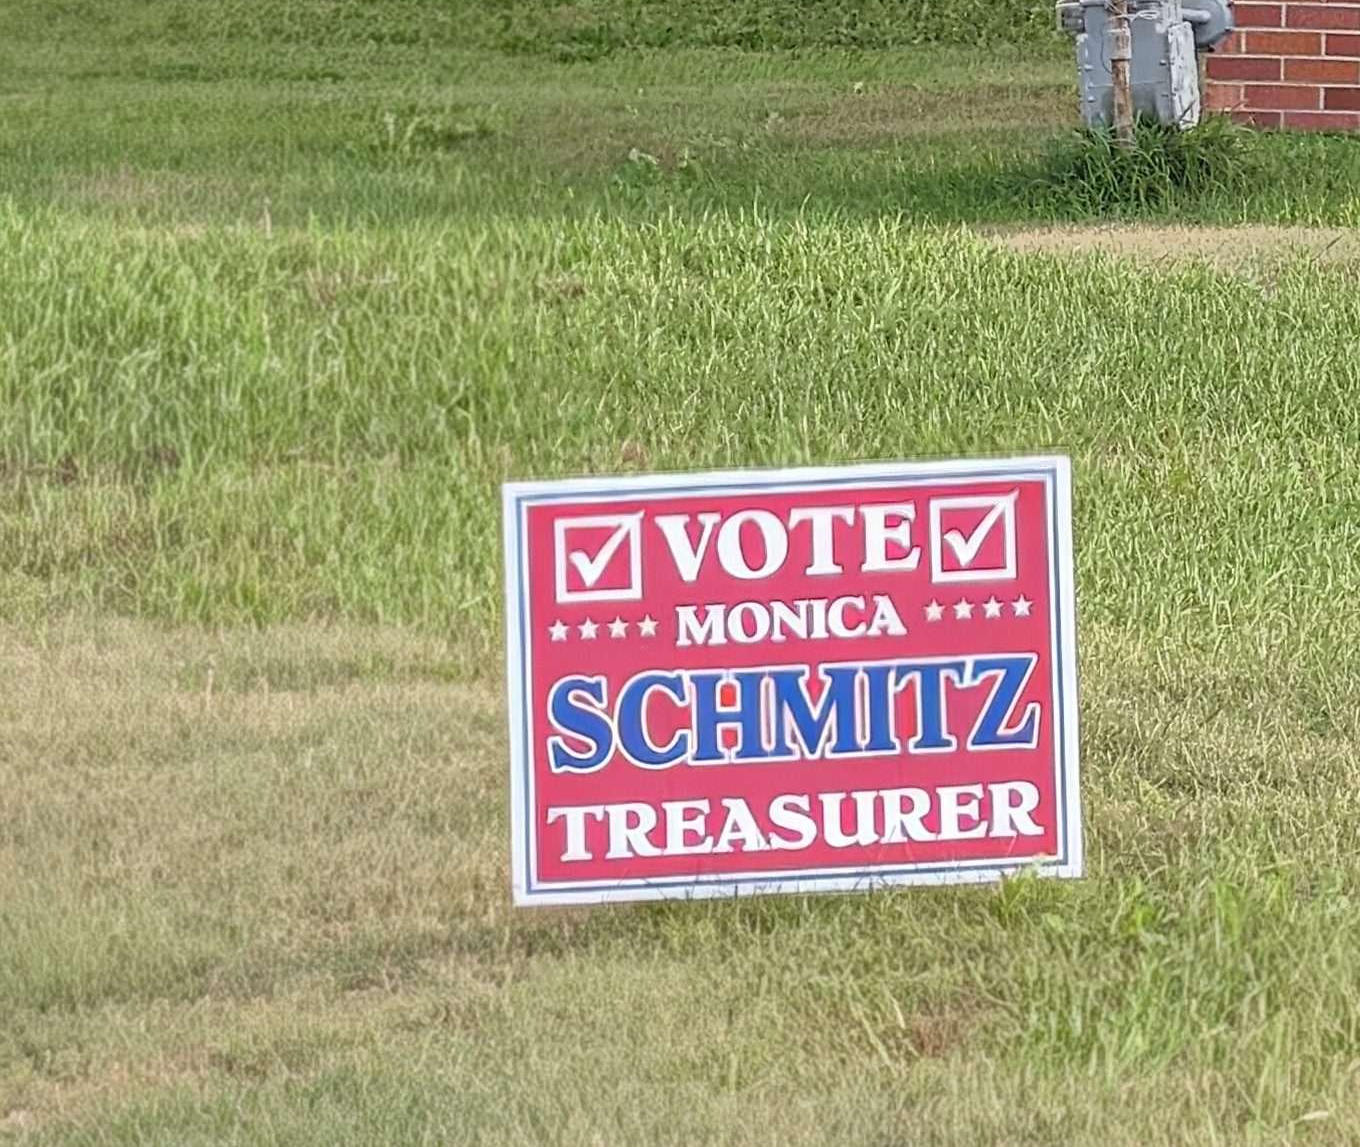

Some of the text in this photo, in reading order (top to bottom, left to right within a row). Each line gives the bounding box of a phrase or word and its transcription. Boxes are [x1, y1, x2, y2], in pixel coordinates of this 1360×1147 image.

[655, 500, 922, 582] VOTE
[675, 594, 908, 647] MONICA
[546, 652, 1040, 774] SCHMITZ
[547, 781, 1046, 862] TREASURER
